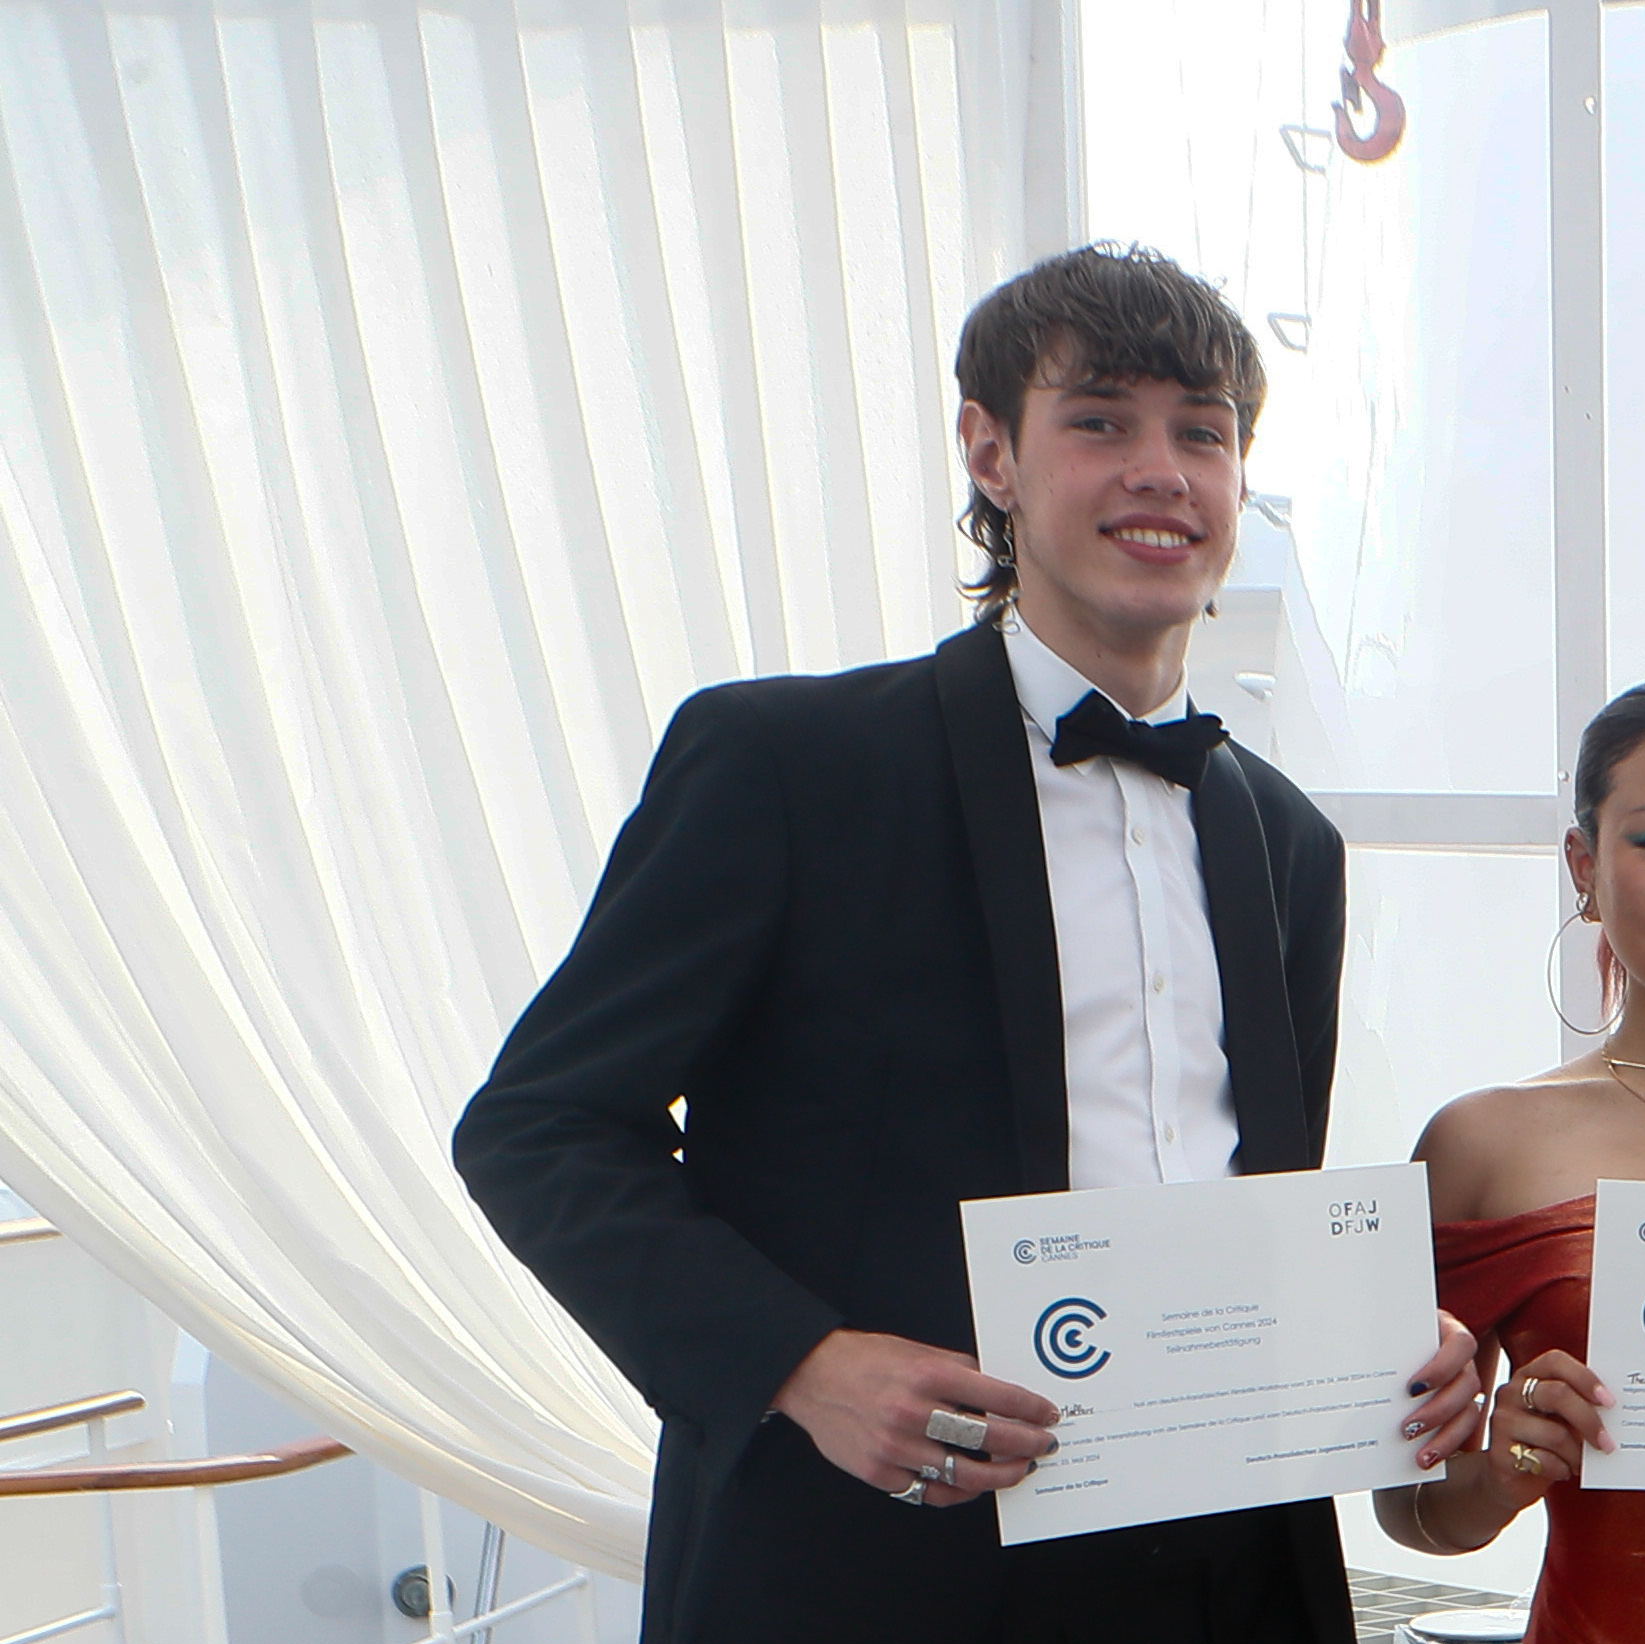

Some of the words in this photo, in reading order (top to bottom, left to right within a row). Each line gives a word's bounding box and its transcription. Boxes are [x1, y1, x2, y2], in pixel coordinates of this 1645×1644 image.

[1329, 1200, 1376, 1217] OFAJ
[1331, 1218, 1379, 1235] DFJW
[1040, 1235, 1079, 1246] SEMAINE
[1041, 1244, 1052, 1255] DE
[1055, 1245, 1066, 1253] LA
[1068, 1240, 1110, 1251] CRITIQUE
[1042, 1252, 1078, 1263] CANNES
